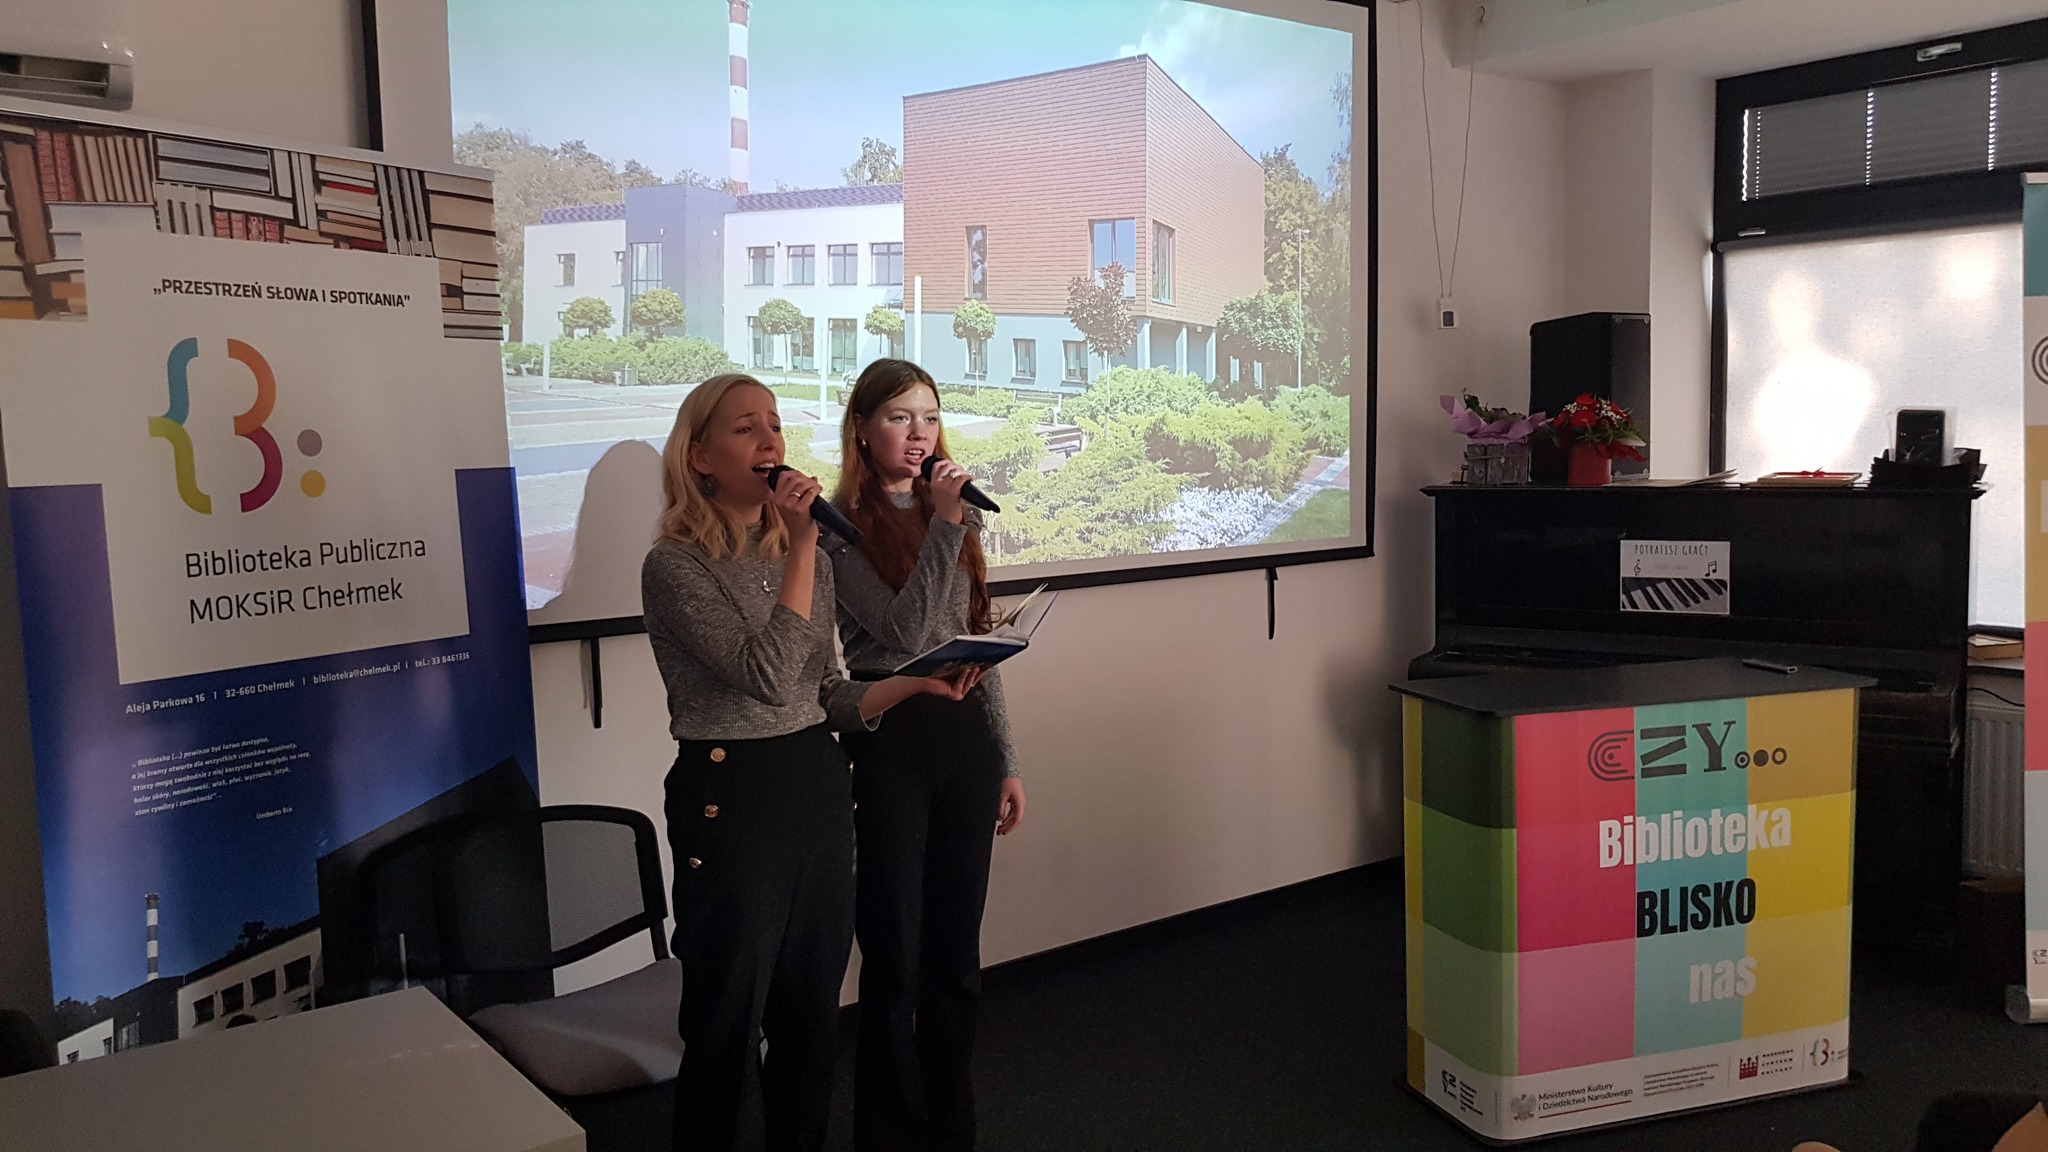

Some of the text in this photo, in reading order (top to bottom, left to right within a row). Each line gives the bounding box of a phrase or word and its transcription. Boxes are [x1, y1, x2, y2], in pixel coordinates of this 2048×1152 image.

[153, 278, 262, 298] „PRZESTRZEŃ
[266, 285, 319, 303] SŁOWA
[330, 290, 410, 308] SPOTKANIA”
[185, 537, 426, 579] Biblioteka Publiczna
[1634, 544, 1678, 555] POTRAFISZ
[190, 577, 403, 624] MOKSiR Chełmek
[126, 701, 150, 714] Aleja
[153, 695, 194, 711] Parkowa
[196, 694, 206, 703] 16
[225, 685, 256, 698] 32-660
[257, 679, 295, 693] Chełmek
[313, 662, 400, 684] biblioteka@chelmek.pl
[431, 656, 441, 666] 33
[138, 755, 170, 766] Biblioteka
[256, 811, 282, 820] Umberto
[1600, 804, 1791, 868] Biblioteka
[1636, 878, 1757, 938] BLISKO
[1689, 956, 1757, 1004] nas
[1539, 1083, 1614, 1101] Ministerstwo Kultury
[1543, 1097, 1586, 1110] Dziedzictwa
[1588, 1089, 1633, 1102] Narodowego
